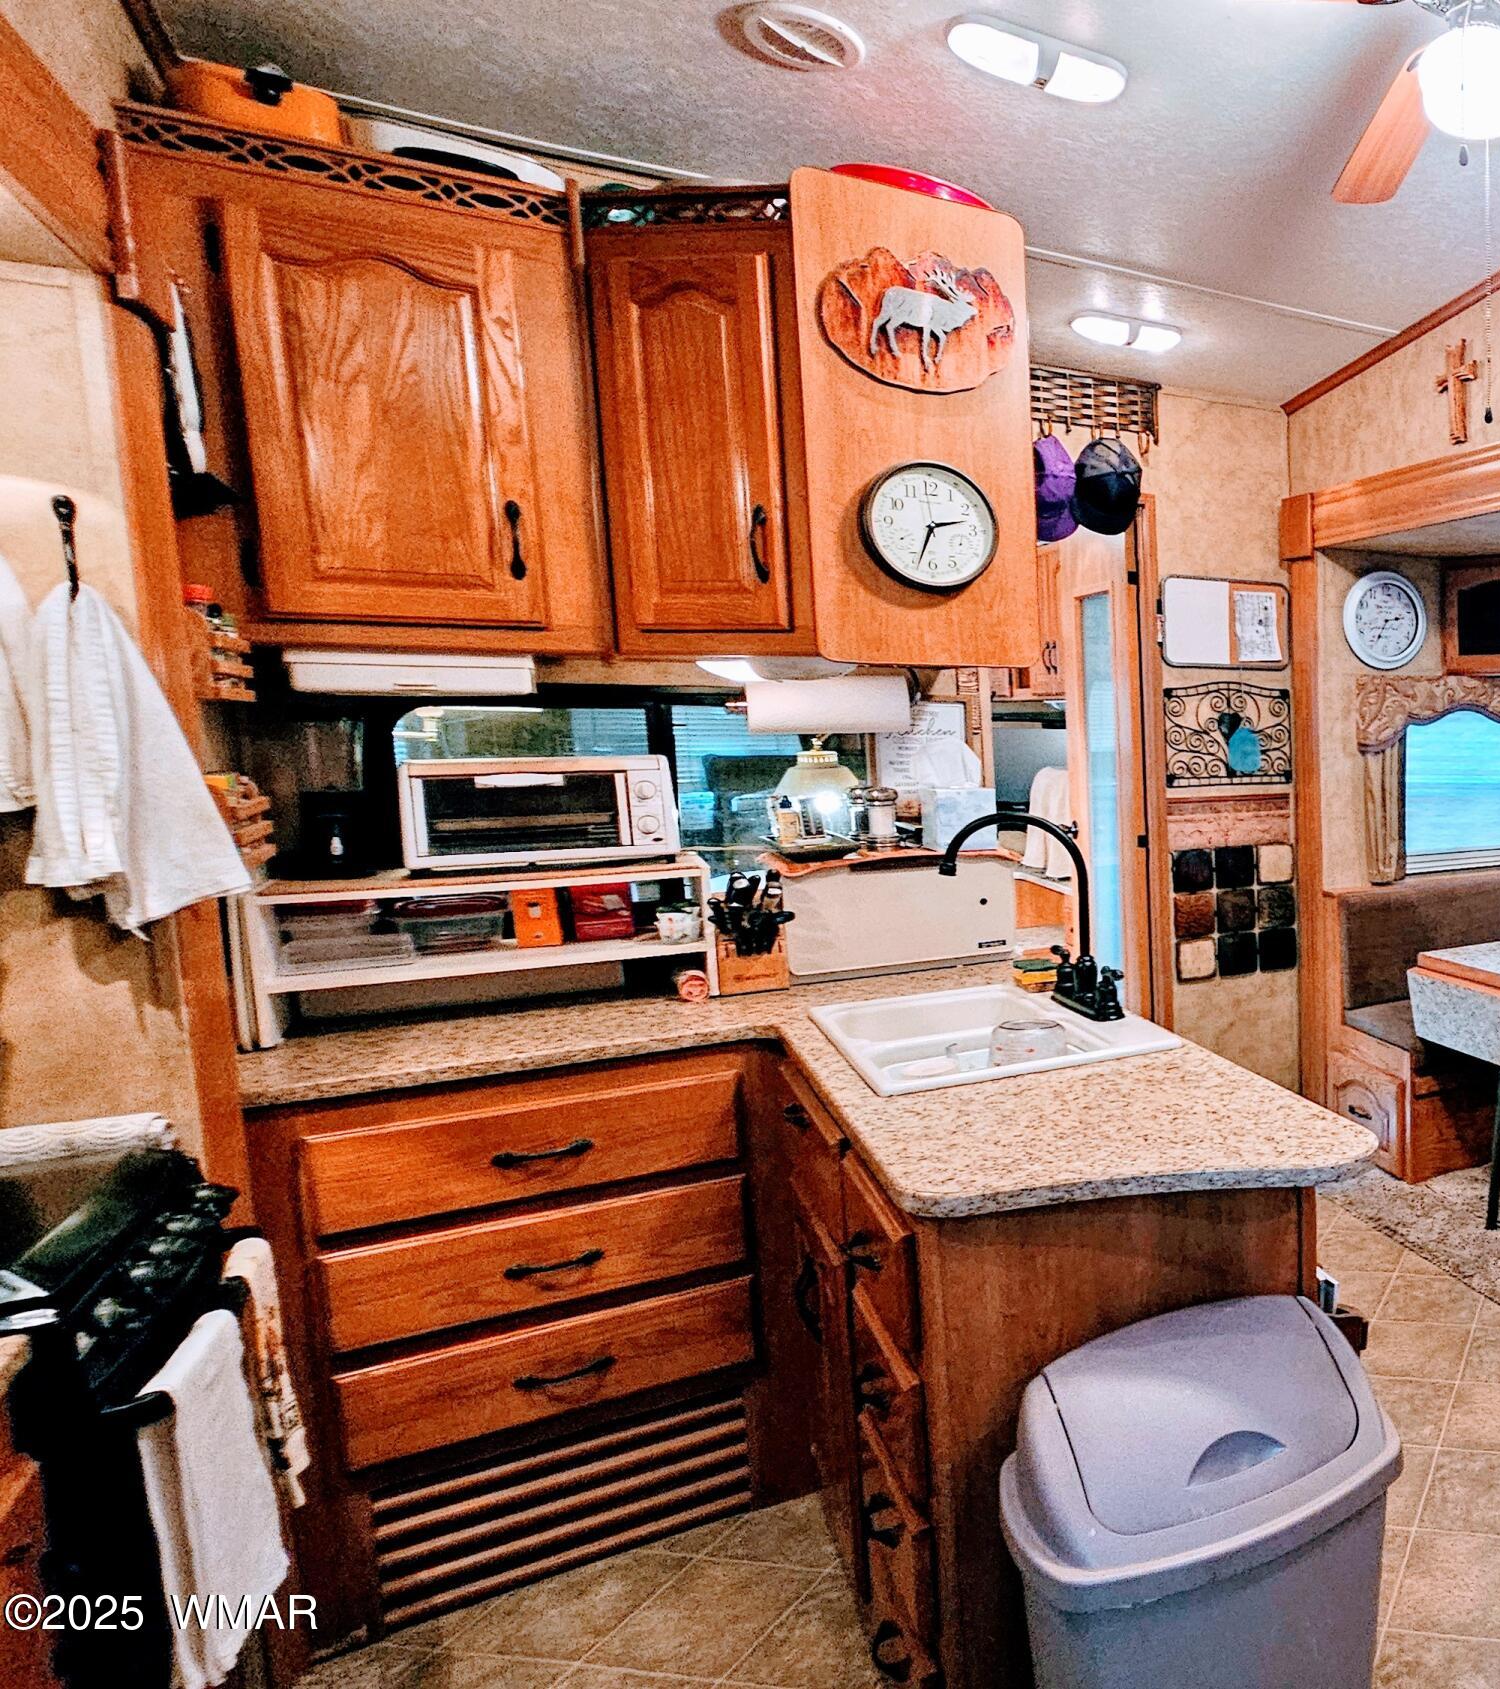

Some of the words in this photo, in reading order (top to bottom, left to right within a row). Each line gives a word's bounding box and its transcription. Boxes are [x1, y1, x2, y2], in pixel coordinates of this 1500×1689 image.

[904, 484, 917, 498] 11
[923, 480, 938, 496] 12
[890, 497, 904, 511] 10
[961, 504, 969, 516] 2
[883, 516, 893, 528] 9
[969, 525, 977, 537] 3
[928, 558, 938, 570] 6
[948, 556, 957, 568] 5
[884, 717, 956, 739] itchen
